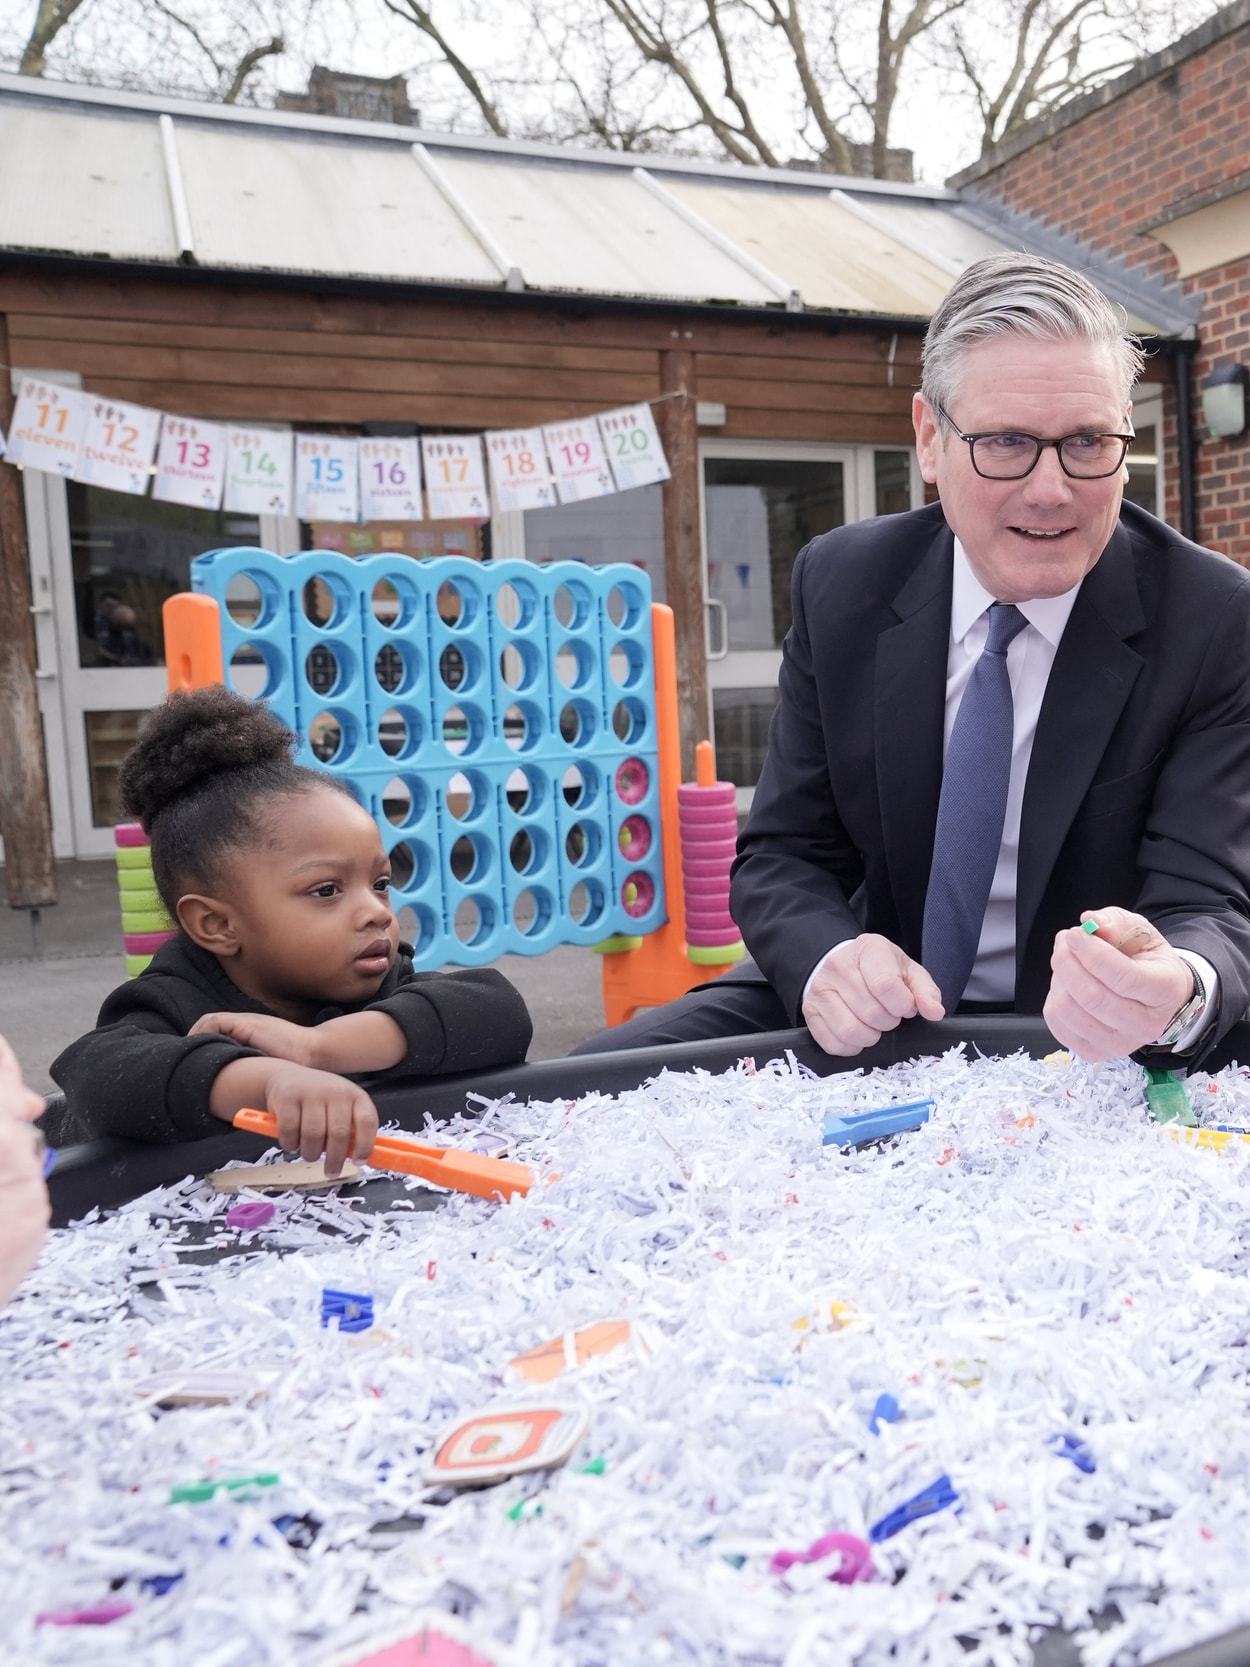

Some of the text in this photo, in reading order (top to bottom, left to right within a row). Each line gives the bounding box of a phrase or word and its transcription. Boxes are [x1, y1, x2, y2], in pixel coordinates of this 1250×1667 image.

[37, 404, 69, 433] 11
[15, 426, 77, 452] eleven
[103, 422, 140, 453] 12
[612, 428, 650, 456] 20
[85, 445, 146, 469] twelve
[177, 440, 212, 469] 13
[241, 450, 278, 475] 14
[503, 451, 536, 477] 18
[561, 441, 591, 468] 19
[163, 464, 216, 482] thirteen
[310, 457, 344, 483] 15
[372, 461, 406, 485] 16
[439, 458, 469, 482] 17
[306, 481, 346, 496] fifteen
